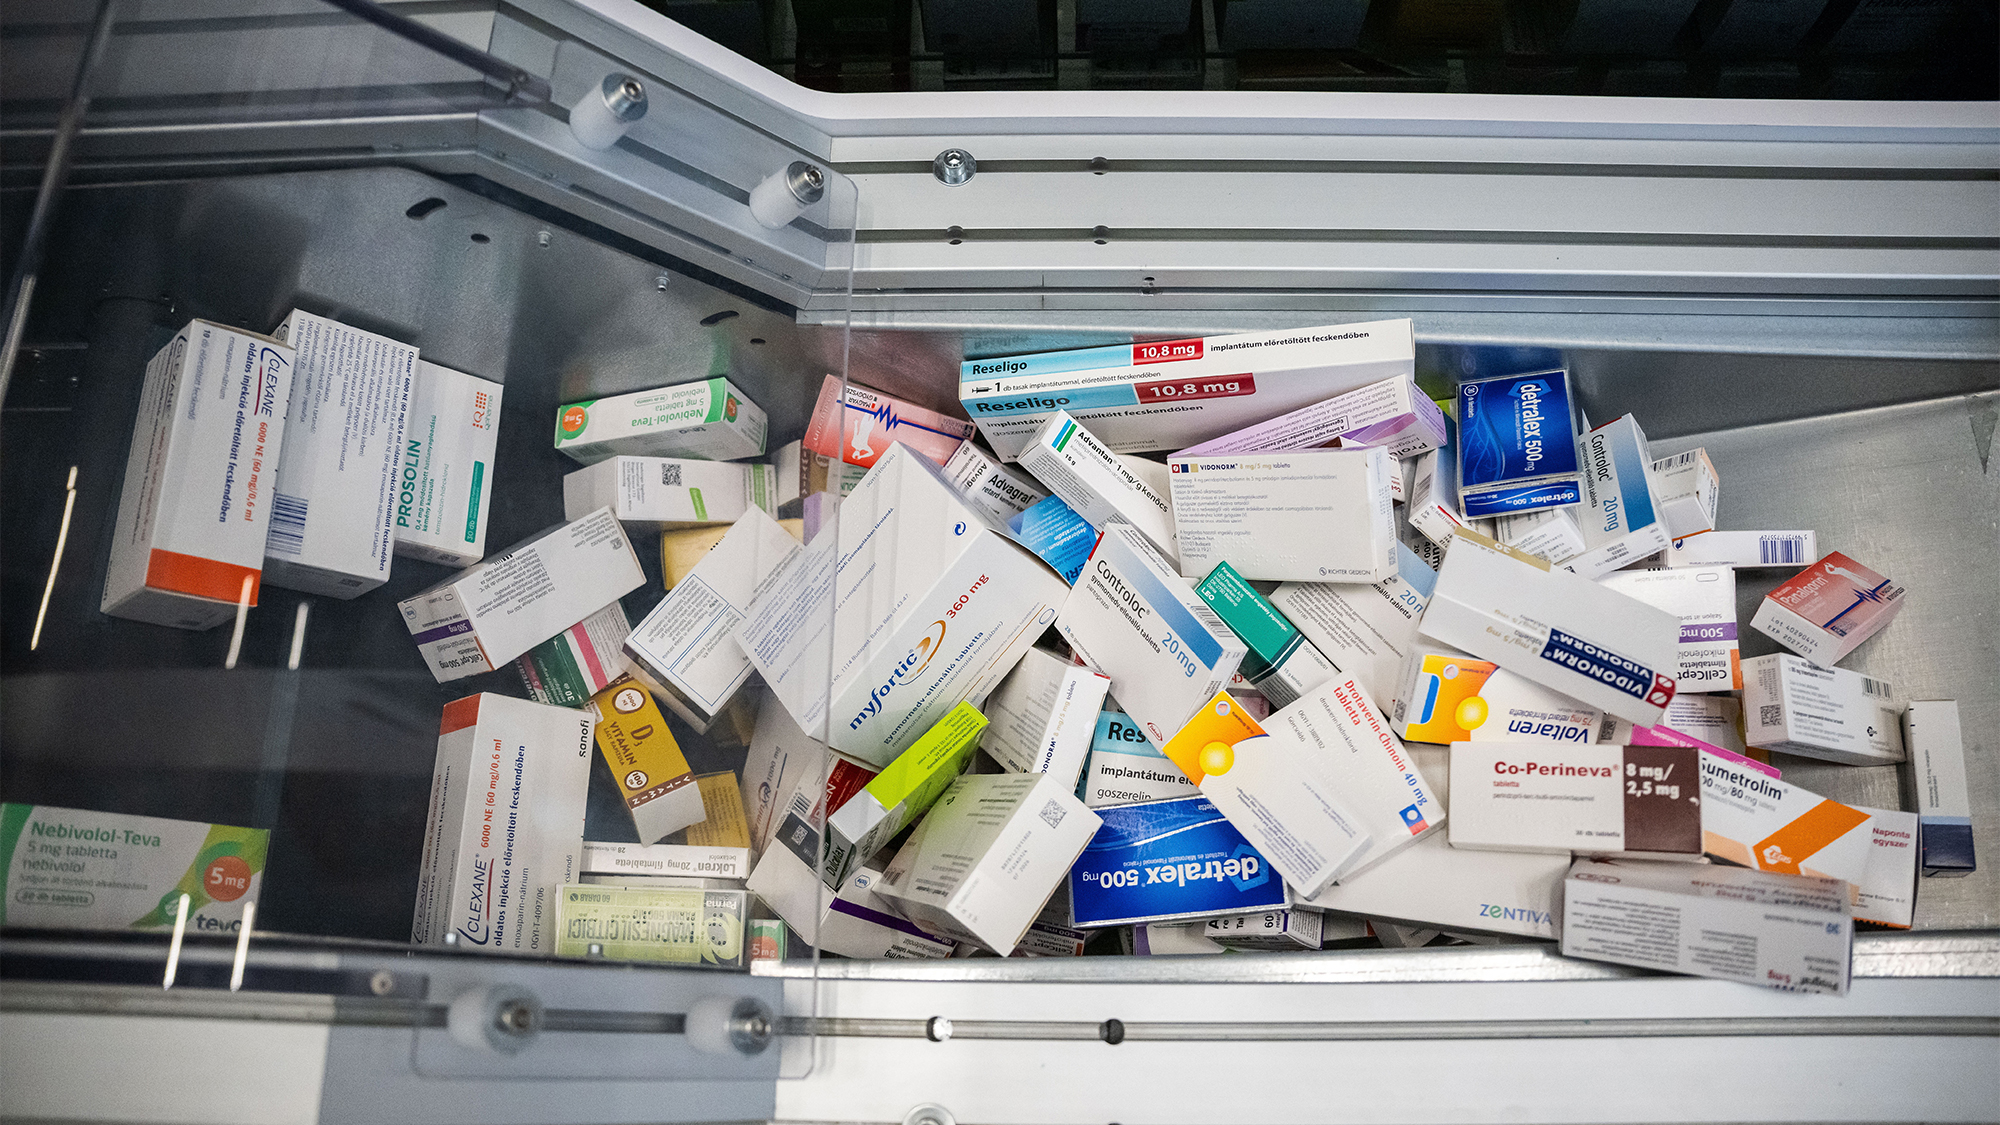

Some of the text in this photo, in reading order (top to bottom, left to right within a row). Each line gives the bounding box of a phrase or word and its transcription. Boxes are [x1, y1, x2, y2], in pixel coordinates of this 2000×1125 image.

[404, 351, 414, 374] Clexane
[973, 331, 1369, 375] Reseligo 10,8 mg implantátum előretöltött fecskendőben
[402, 377, 411, 392] 6000
[671, 387, 705, 399] nebivolol
[401, 392, 408, 401] NE
[654, 397, 704, 412] 5 mg tabletta
[977, 380, 1240, 413] Reseligo 10,8 mg
[564, 414, 583, 424] 5 mg
[630, 407, 704, 428] Nebivolol-Teva
[1518, 383, 1546, 471] detralex 500 mg
[217, 342, 258, 523] oldatos injekció előretöltött fecskendőben
[243, 358, 281, 521] CLEXANE 6000 NE (60 mg)/0,6 ml
[395, 435, 403, 444] ml
[391, 444, 402, 467] oldatos
[1076, 431, 1115, 464] Advantan
[1118, 468, 1144, 491] mg/g
[1587, 434, 1614, 481] Controloc
[387, 467, 399, 491] injekció
[394, 439, 423, 527] PROSOLIN
[417, 470, 429, 506] módosított
[989, 473, 1036, 505] Advagraf
[416, 507, 423, 517] mg
[421, 478, 435, 531] kemény kapszula
[1602, 496, 1619, 512] 20
[414, 519, 422, 530] 0,4
[466, 519, 475, 540] 30 db
[1600, 512, 1621, 531] mg
[1200, 587, 1215, 601] LEO
[1399, 589, 1417, 607] 20
[1779, 572, 1830, 611] Panalgorin
[1388, 597, 1412, 619] tabletta
[447, 622, 467, 633] 500 mg
[1093, 559, 1150, 619] Controloc
[1159, 632, 1181, 654] 20
[1172, 650, 1200, 678] mg
[1770, 616, 1783, 627] Lot
[1484, 624, 1501, 638] mg
[1513, 628, 1543, 647] tabletta
[1679, 627, 1723, 638] 500 mg
[1766, 624, 1780, 635] EXP
[953, 629, 984, 662] tabletta
[1138, 629, 1162, 654] tabletta
[438, 651, 483, 670] CellCept 500 mg
[844, 649, 924, 734] myfortic
[945, 593, 970, 619] 360
[968, 572, 990, 595] mg
[1557, 631, 1652, 680] VIDONORM
[1550, 645, 1645, 696] VIDONORM
[1679, 659, 1726, 668] filmtabletta
[1676, 669, 1726, 681] CellCept
[564, 689, 575, 702] 30
[1332, 686, 1363, 726] tabletta
[1508, 707, 1592, 726] 75 mg retard filmtabletta
[576, 719, 590, 757] sanofi
[1507, 717, 1588, 744] Voltaren
[607, 720, 637, 766] VITAMIN
[1343, 678, 1428, 807] Drotaverin-Chinoin 40 mg
[763, 745, 783, 782] 1000 mg
[1495, 762, 1612, 777] Co-Perineva
[1626, 764, 1674, 779] 8 mg/
[631, 771, 643, 785] 100
[1101, 765, 1175, 783] implantátum
[1493, 780, 1519, 788] tabletta
[631, 770, 690, 809] VITAMIN
[1627, 782, 1679, 799] 2,5 mg
[31, 822, 160, 847] Nebivolol-Teva
[466, 738, 502, 933] CLEXANE 6000 NE (60 mg)/0,6 ml
[1873, 828, 1911, 839] Naponta
[1873, 837, 1909, 849] egyszer
[29, 841, 117, 859] 5 mg tabletta
[492, 744, 526, 946] oldatos injekció előretöltött fecskendőben
[23, 859, 85, 873] nebivolol
[615, 858, 735, 874] Lokren 20mg filmtabletta
[1082, 855, 1259, 890] detralex 500 mg
[211, 867, 246, 889] 5 mg
[511, 867, 531, 948] enoxaparin-nátrium
[579, 893, 610, 902] 60 DARAB
[704, 899, 736, 909] Parma
[529, 886, 545, 949] OGYI-T-4097/06
[1264, 914, 1274, 928] 60
[567, 918, 617, 939] CITRICI
[751, 943, 775, 959] 5 mg
[1033, 942, 1072, 954] CellCept
